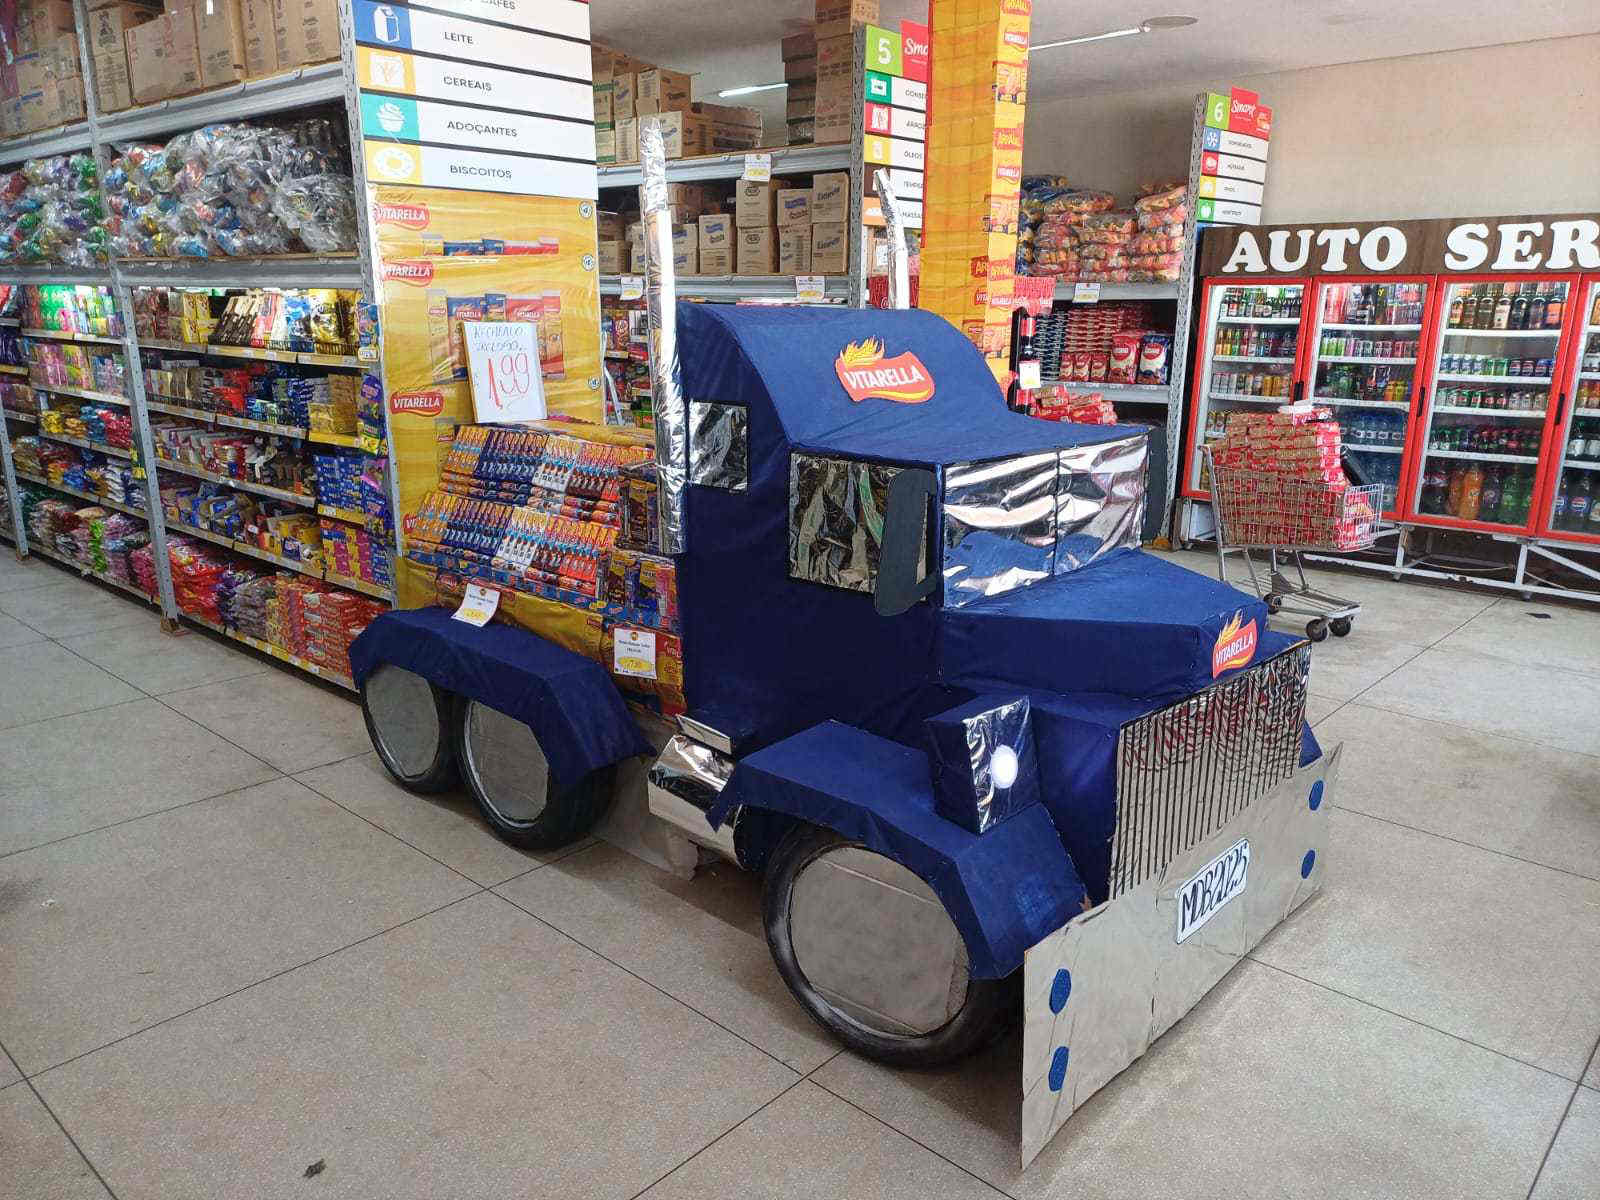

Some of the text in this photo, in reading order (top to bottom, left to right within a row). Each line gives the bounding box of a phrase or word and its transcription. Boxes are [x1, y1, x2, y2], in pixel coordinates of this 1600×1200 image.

[444, 31, 474, 45] LEITE
[877, 38, 891, 65] 5
[443, 75, 492, 92] CEREAIS
[1215, 102, 1224, 122] 6
[447, 120, 518, 138] ADOÇANTES
[449, 164, 512, 179] BISCOITOS
[1221, 219, 1600, 273] AUTO SER
[843, 365, 925, 390] VITARELLA
[393, 396, 441, 409] VITARELLA
[1215, 631, 1255, 667] VITARELLA
